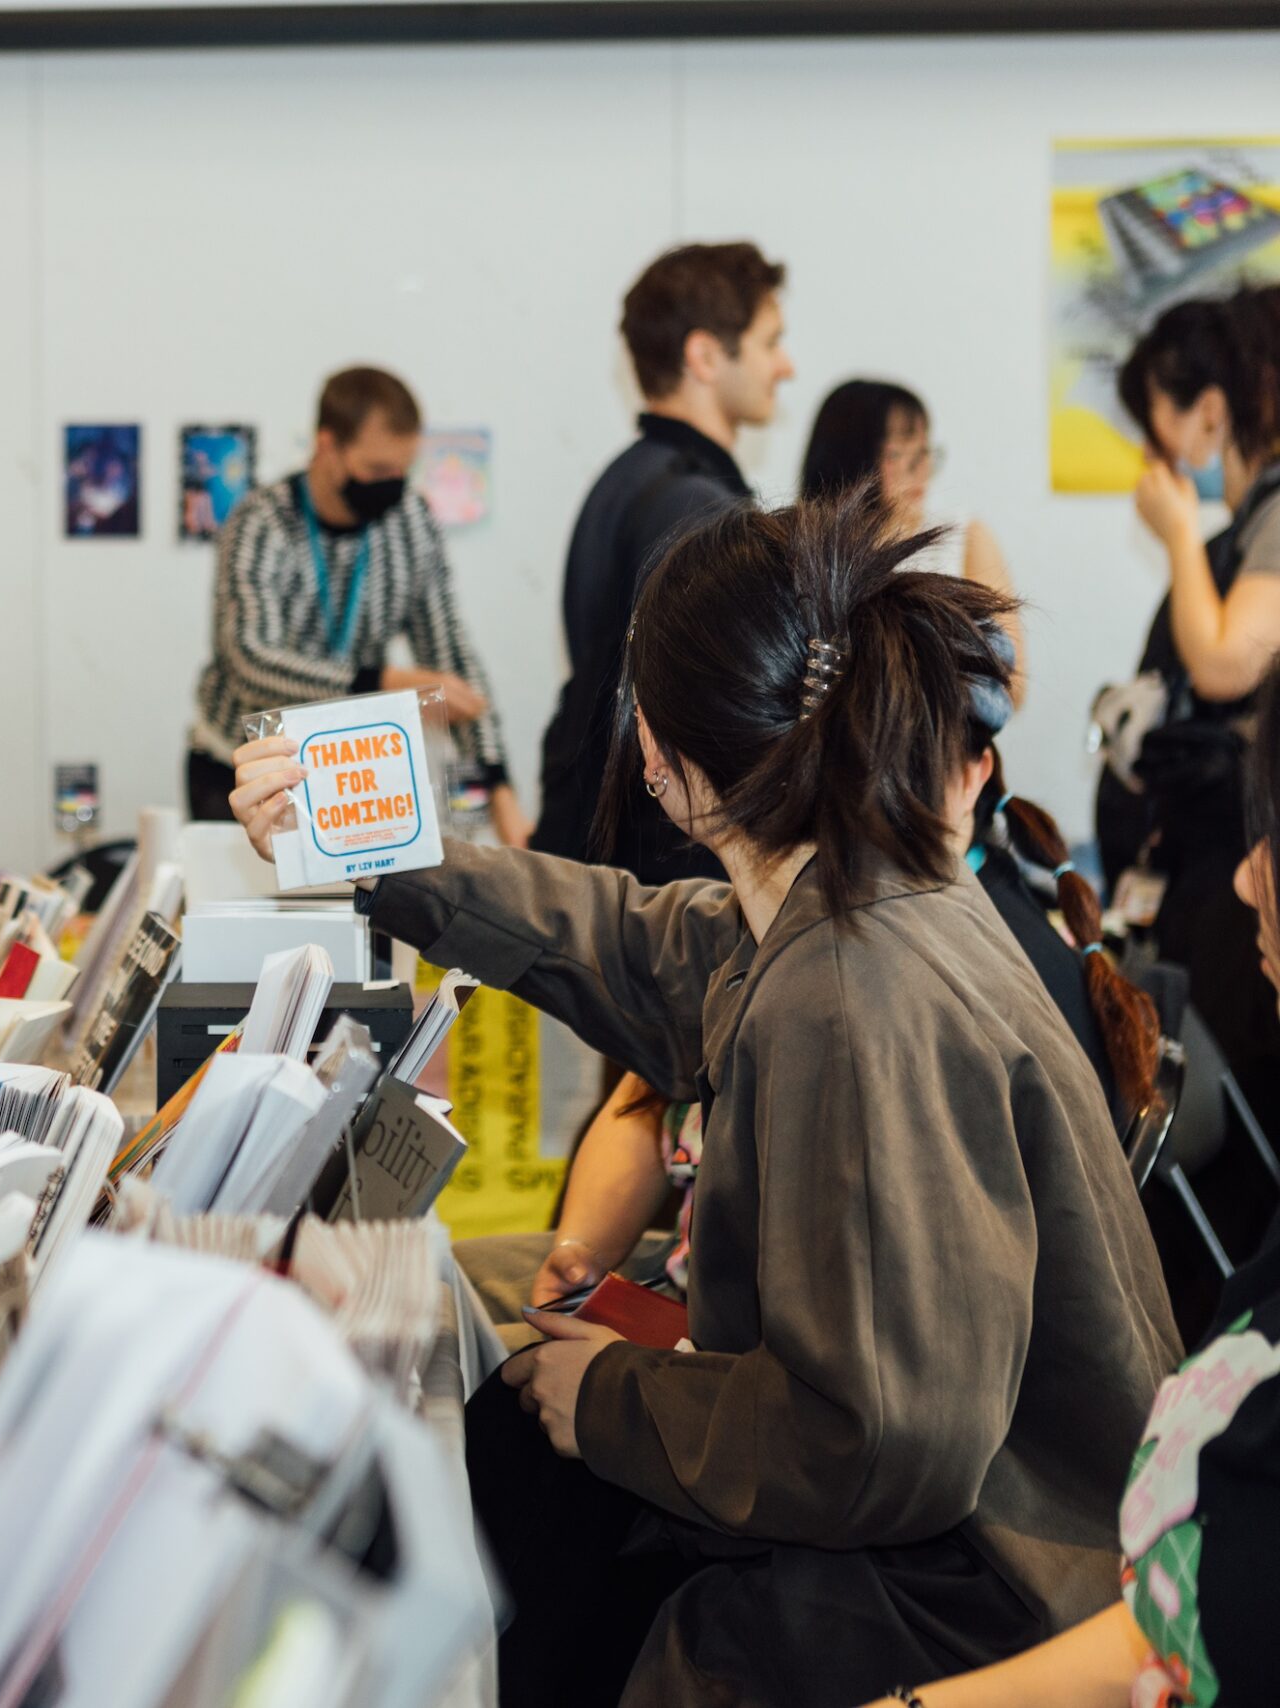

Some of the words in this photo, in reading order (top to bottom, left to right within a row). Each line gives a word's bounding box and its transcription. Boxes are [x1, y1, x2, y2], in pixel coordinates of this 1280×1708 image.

[308, 733, 402, 768] THANKS
[336, 769, 378, 796] FOR
[317, 793, 413, 831] COMING!
[346, 863, 356, 873] BY
[358, 861, 373, 871] LIV
[374, 857, 396, 868] HART
